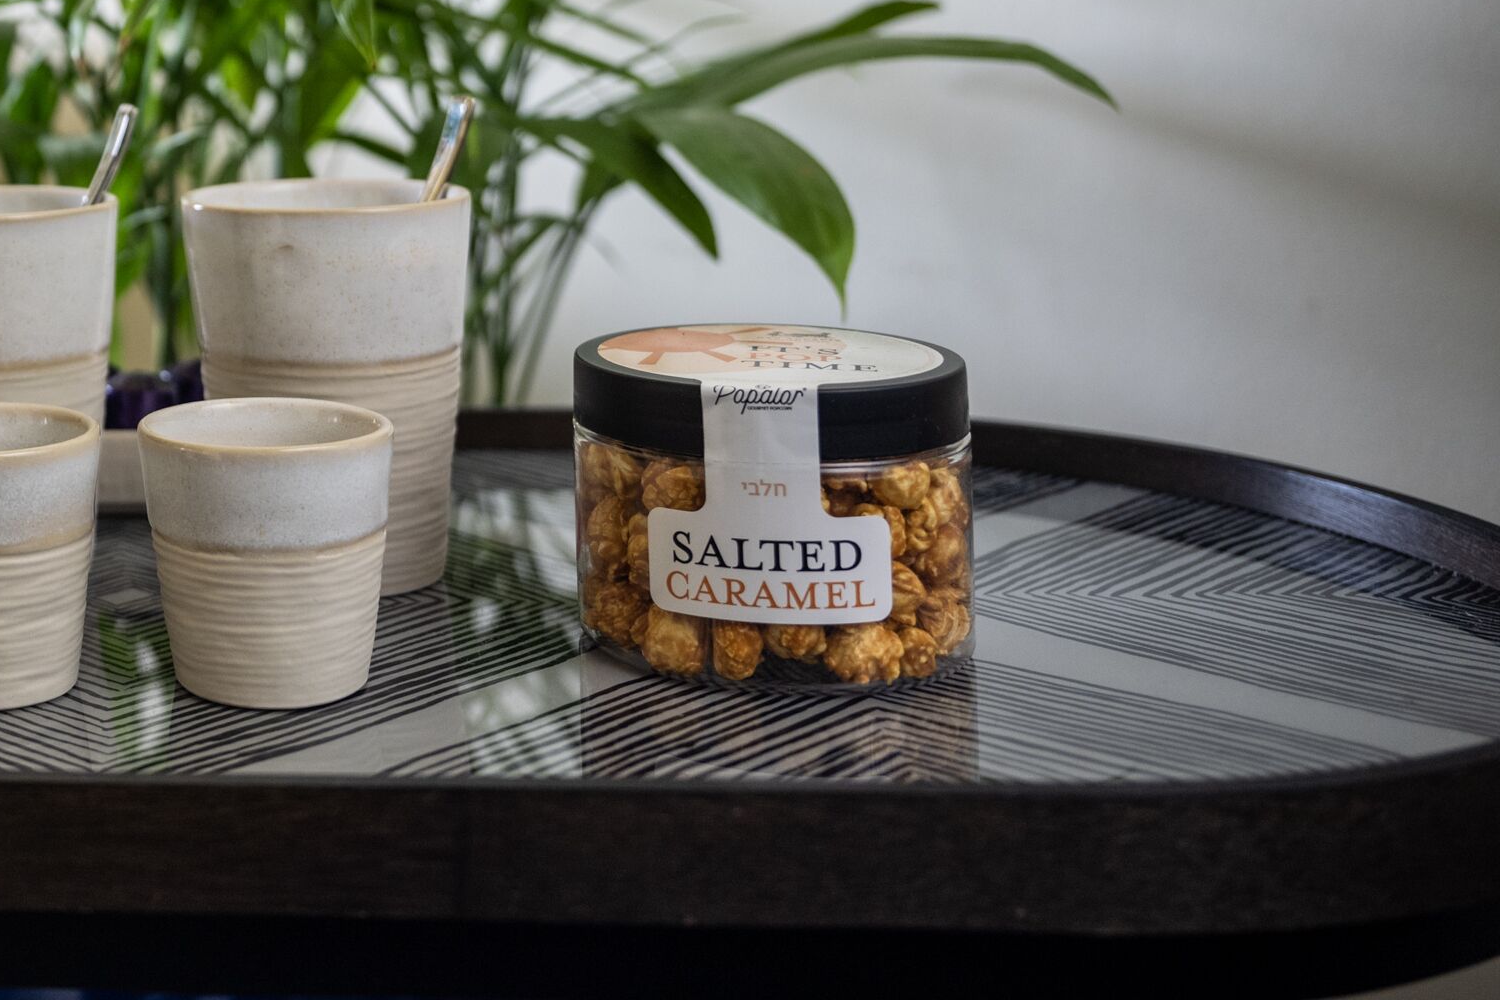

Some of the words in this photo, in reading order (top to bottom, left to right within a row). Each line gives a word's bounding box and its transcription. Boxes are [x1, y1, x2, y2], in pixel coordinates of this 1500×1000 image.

[741, 360, 878, 372] TIME
[750, 353, 842, 361] POP
[740, 479, 787, 497] חלבי
[672, 530, 862, 572] SALTED
[666, 571, 876, 611] CARAMEL
